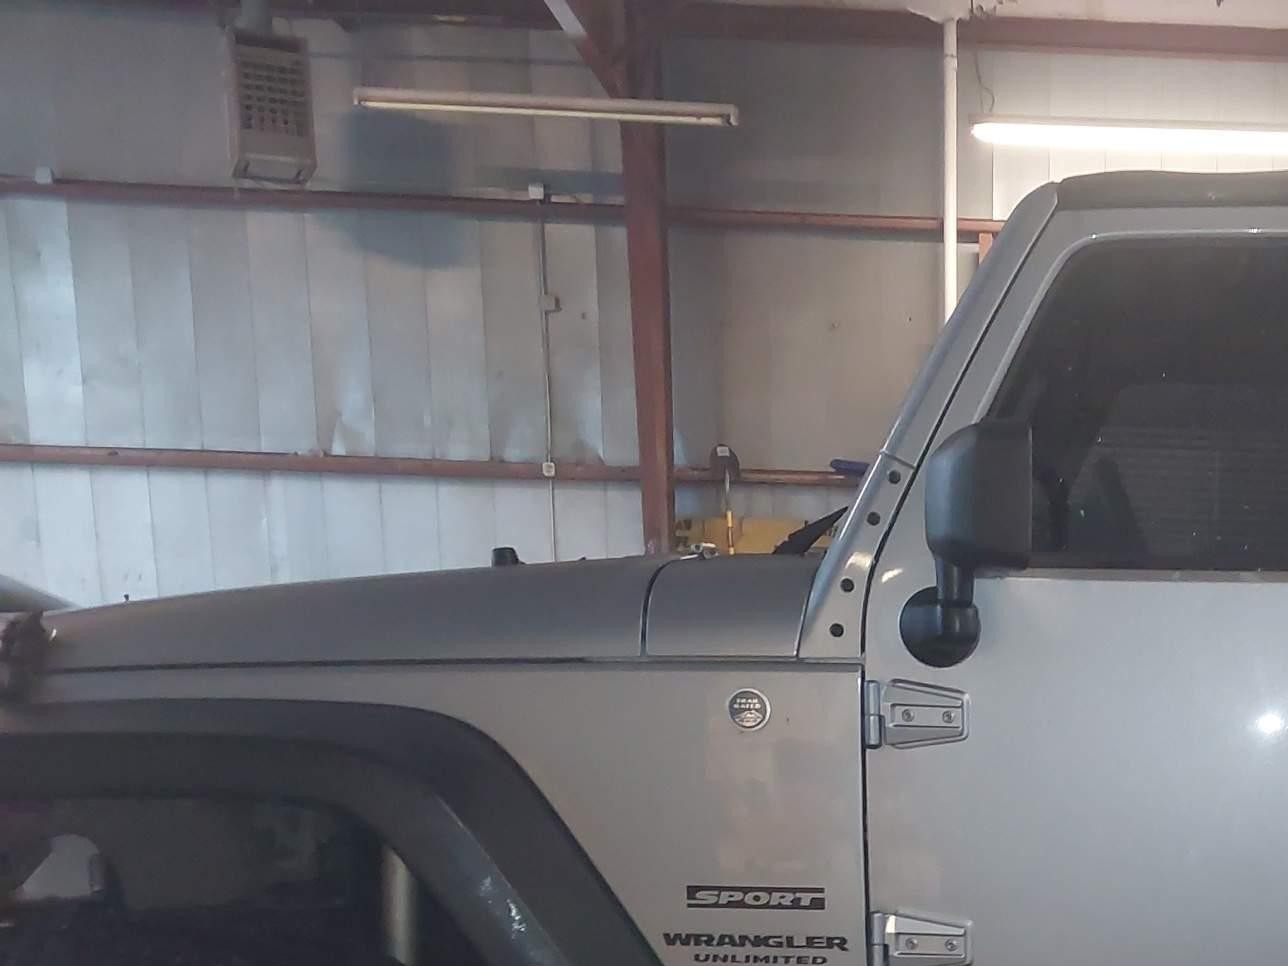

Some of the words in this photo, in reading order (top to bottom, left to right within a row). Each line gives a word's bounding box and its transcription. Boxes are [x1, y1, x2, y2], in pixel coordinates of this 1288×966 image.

[687, 890, 826, 907] SPORT
[662, 932, 849, 952] WRANGLER
[693, 953, 828, 966] UNLIMITED
